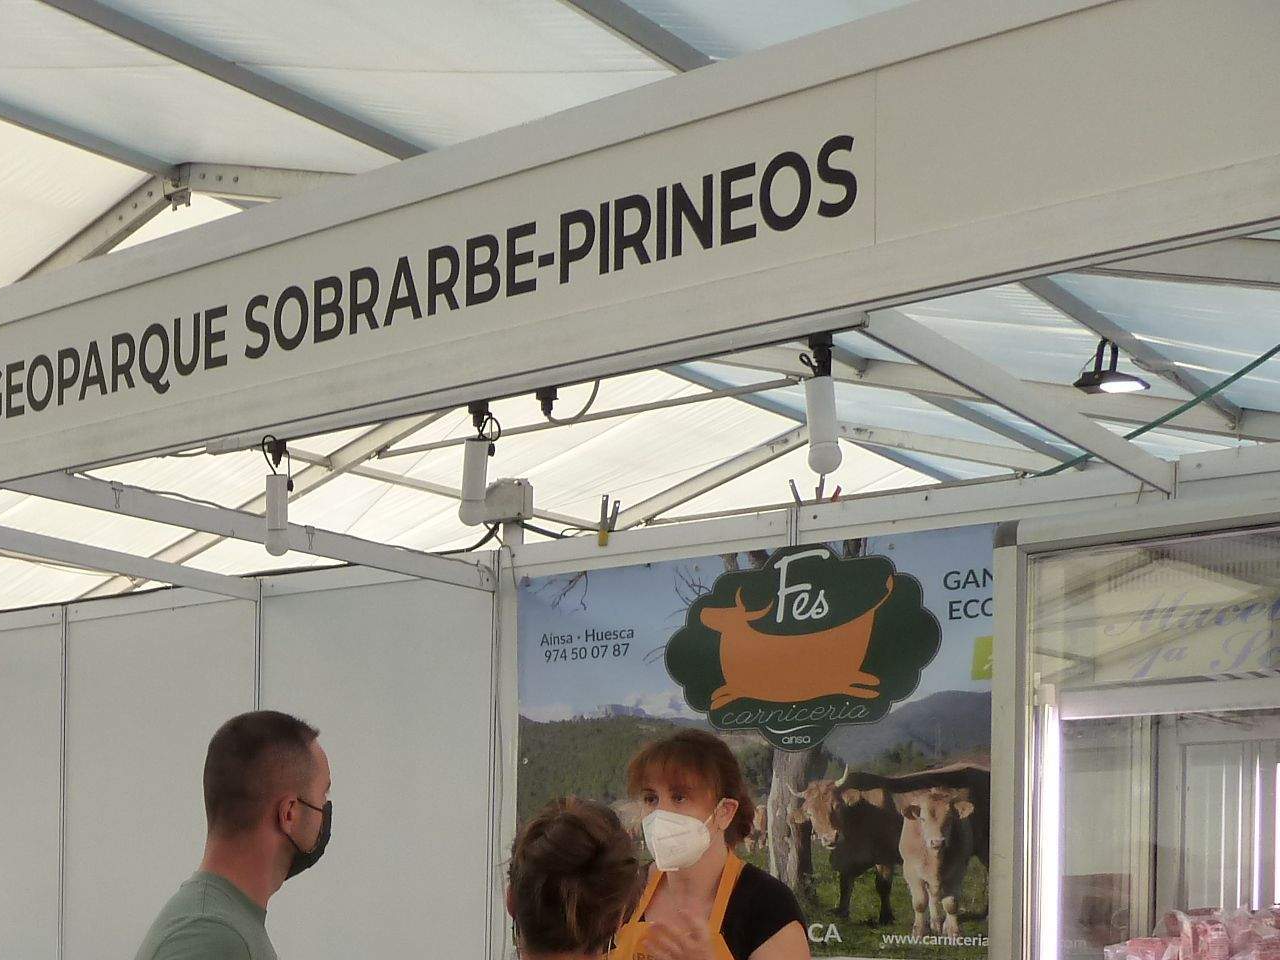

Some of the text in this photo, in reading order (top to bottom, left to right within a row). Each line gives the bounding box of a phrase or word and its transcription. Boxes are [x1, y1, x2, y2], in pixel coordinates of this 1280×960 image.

[244, 134, 858, 360] SOBRARBE-PIRINEOS
[773, 548, 830, 624] Fes
[544, 642, 630, 663] 974 50 07 87
[585, 628, 635, 643] Huesca
